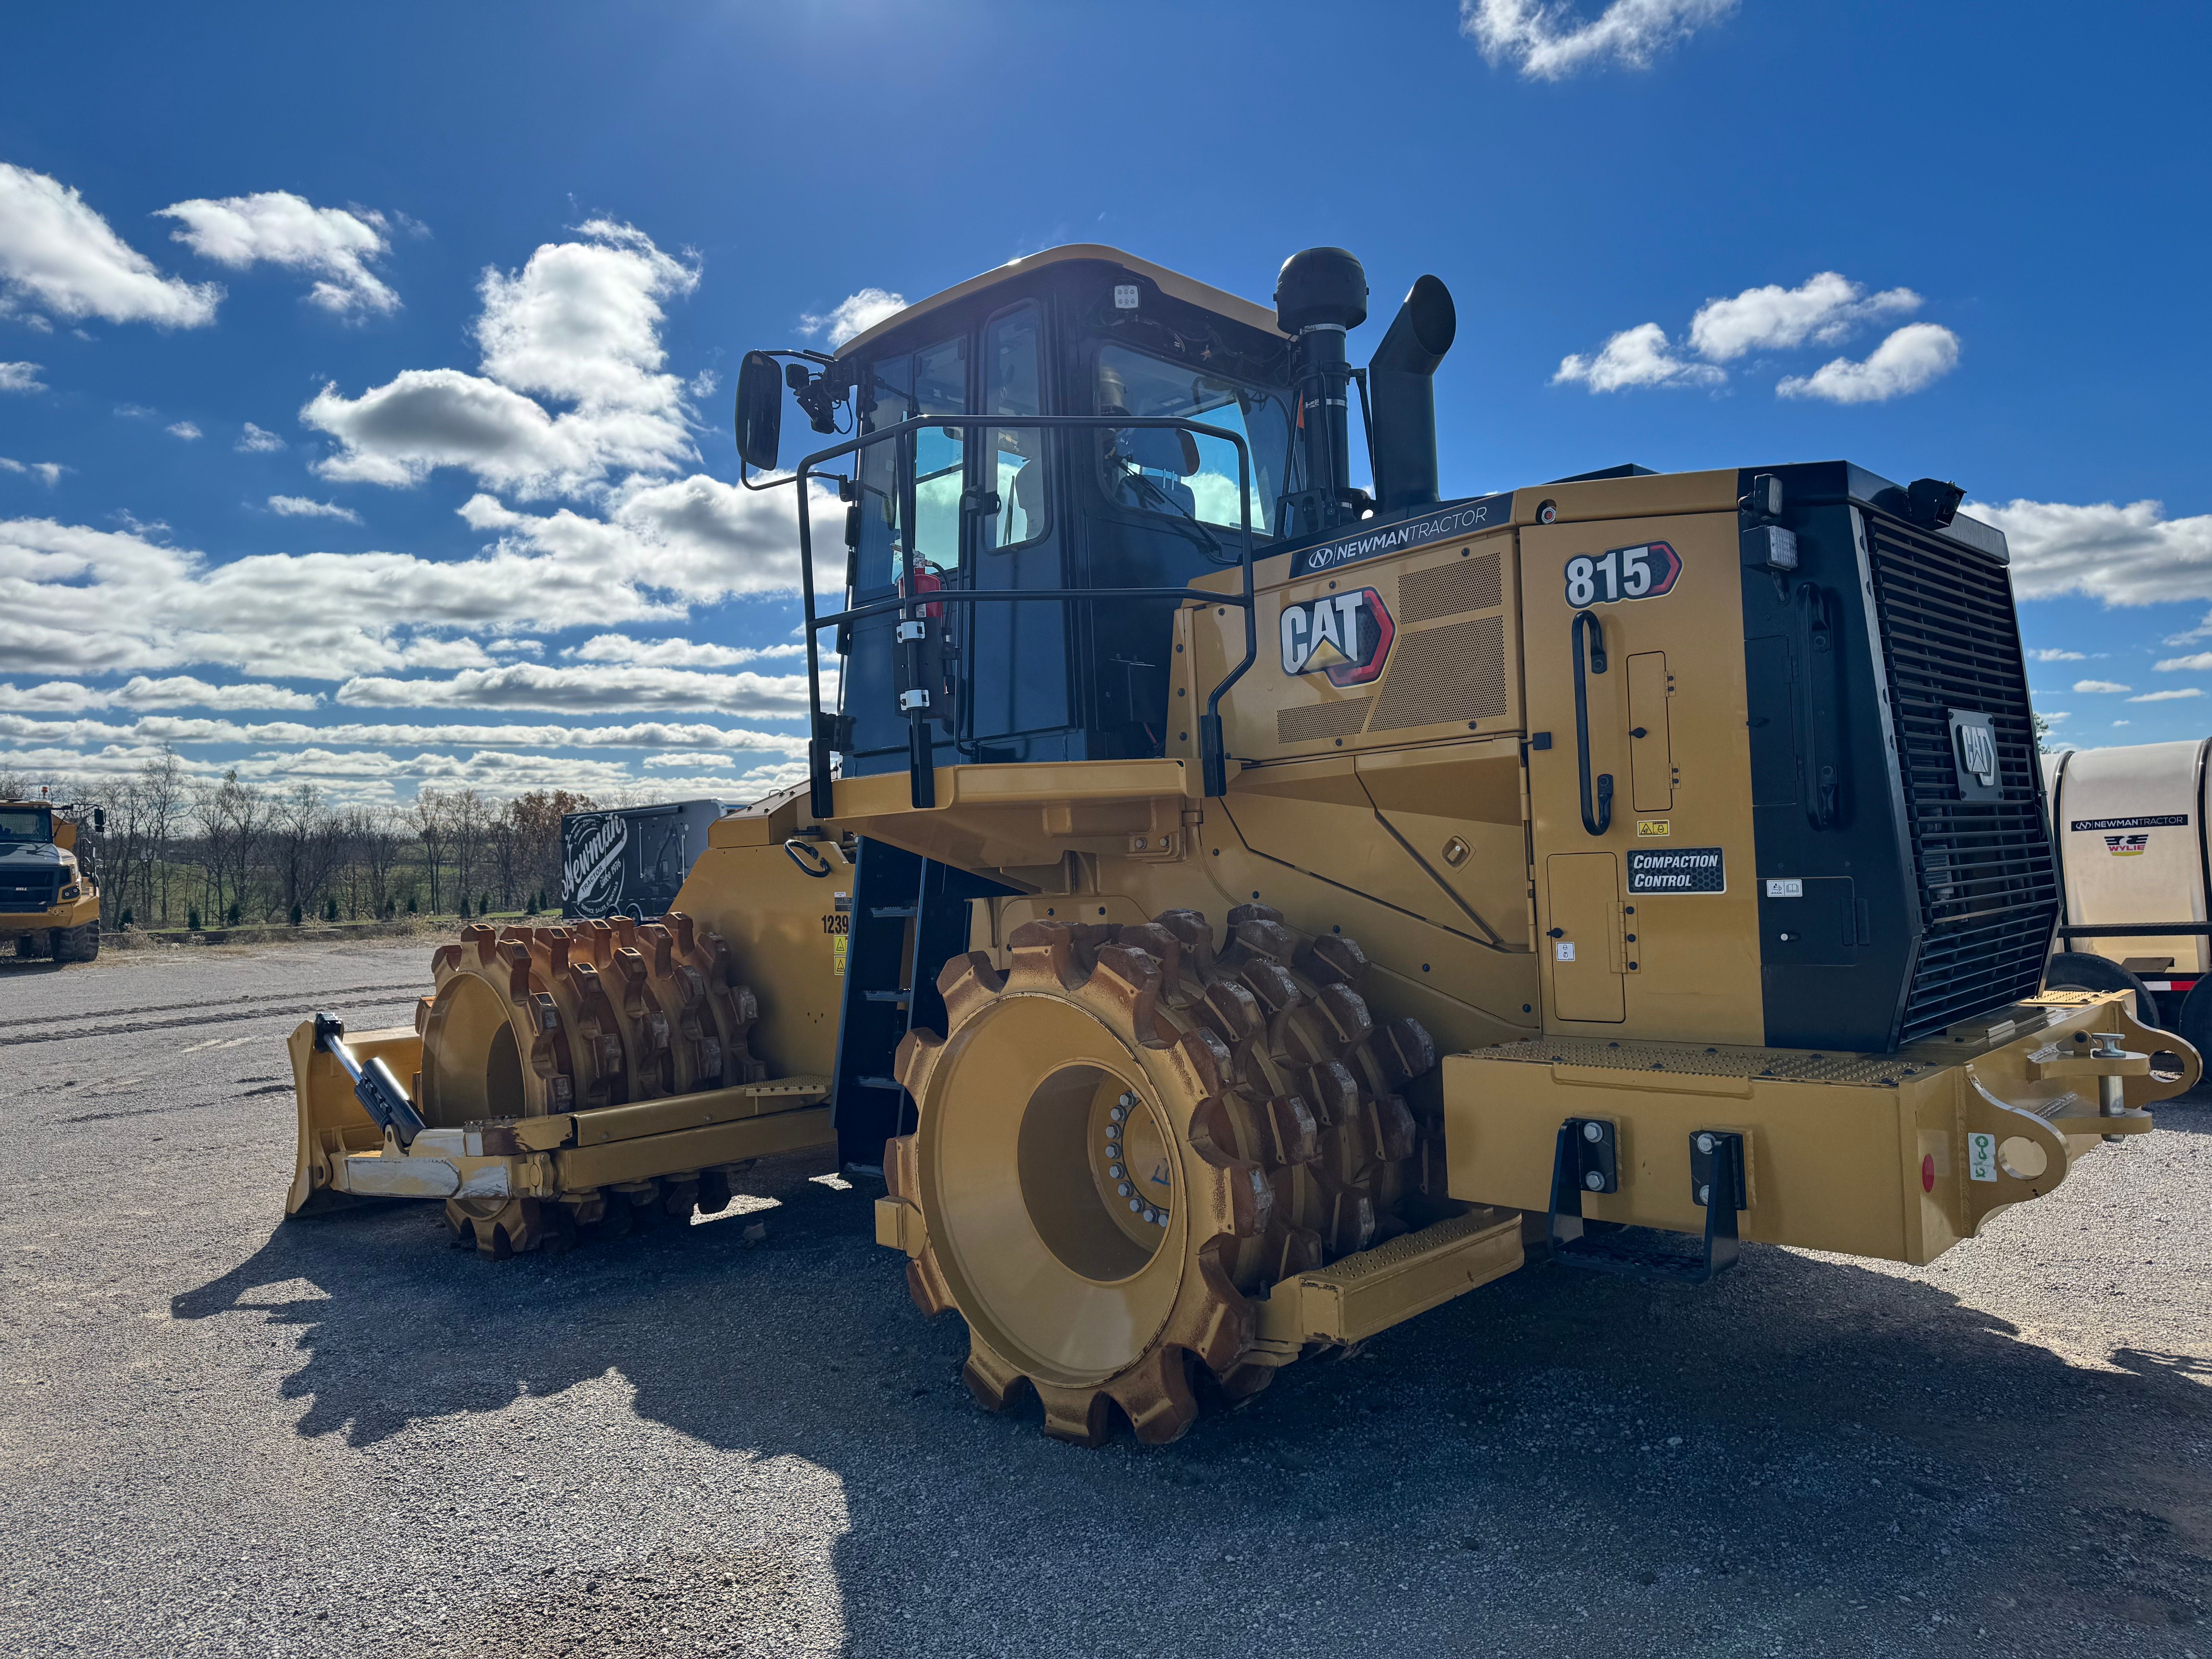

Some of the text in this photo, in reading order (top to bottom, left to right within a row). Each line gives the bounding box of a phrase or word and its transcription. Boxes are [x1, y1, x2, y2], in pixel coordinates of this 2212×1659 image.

[1567, 546, 1651, 605] 815
[1281, 591, 1363, 673] CAT
[1962, 725, 1988, 773] CAT
[562, 812, 627, 901] Newman
[611, 858, 621, 875] 1976
[1633, 855, 1718, 869] COMPACTION
[582, 866, 603, 893] TRACTOR
[1634, 873, 1692, 888] CONTROL
[581, 903, 595, 914] SERVICE
[595, 904, 607, 914] SALES
[821, 915, 850, 934] 1239
